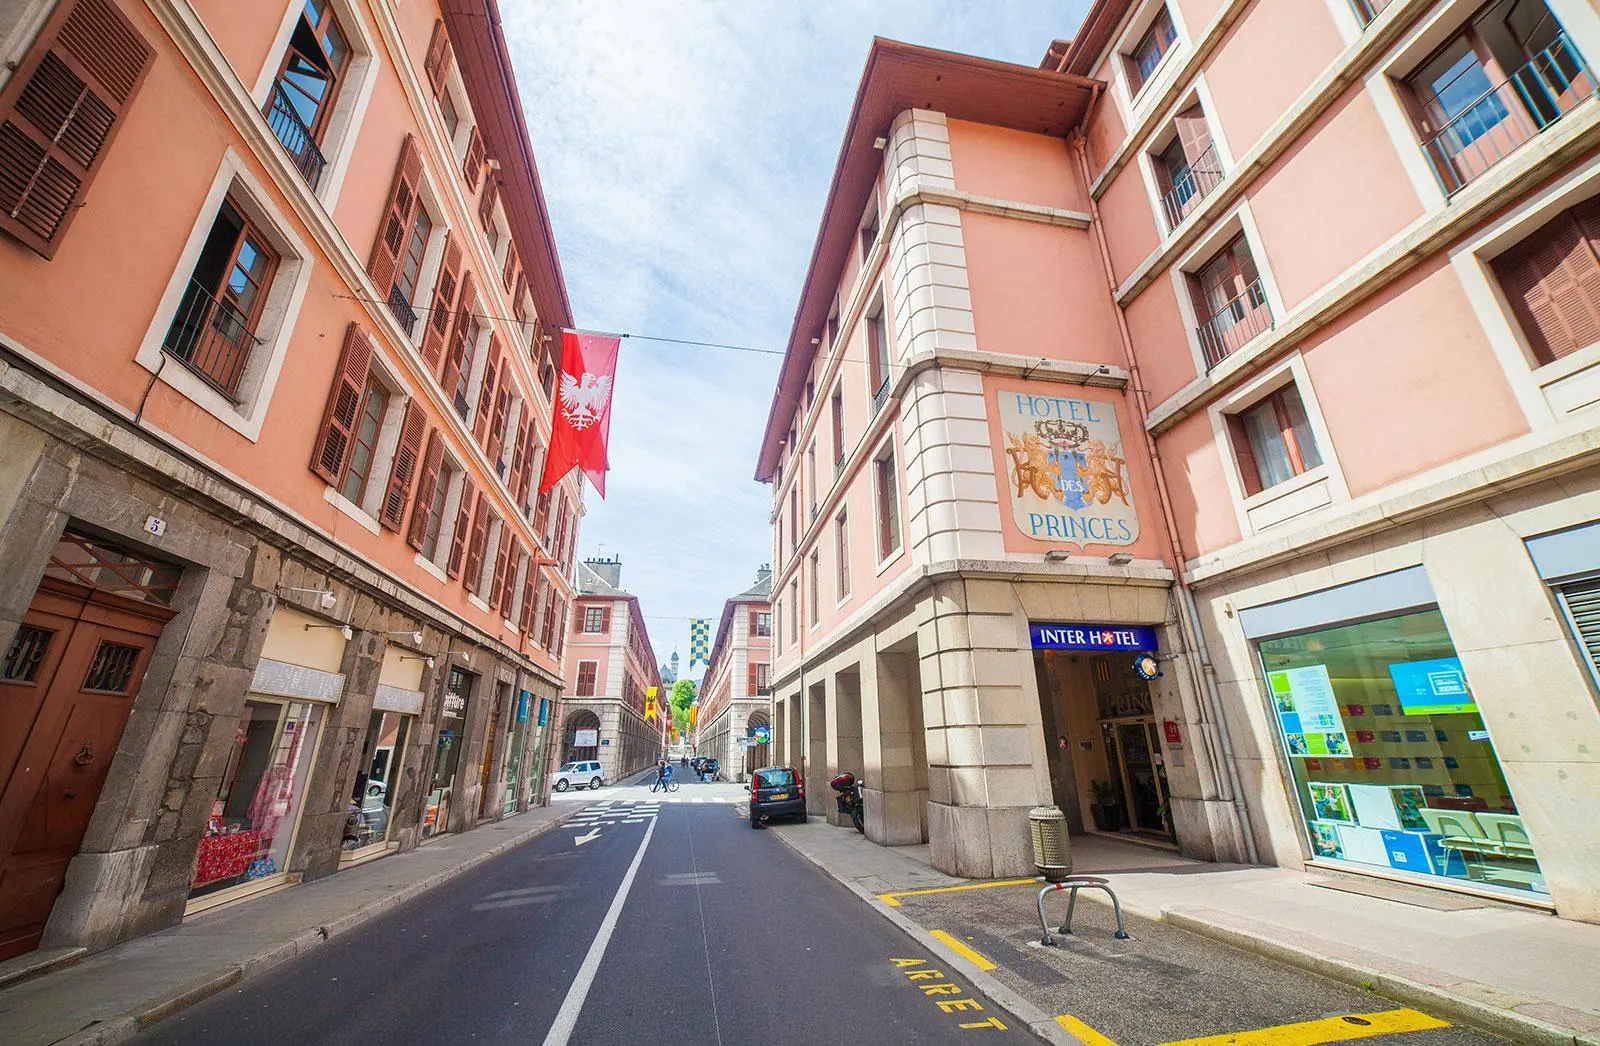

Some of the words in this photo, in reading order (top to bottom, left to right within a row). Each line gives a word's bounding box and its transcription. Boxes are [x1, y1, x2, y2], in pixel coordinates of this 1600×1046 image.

[1016, 394, 1101, 423] HOTEL
[1060, 479, 1084, 493] DES
[150, 519, 160, 532] 5
[1028, 513, 1131, 541] PRINCES
[1040, 629, 1086, 644] INTER
[888, 957, 1009, 1031] ARRET
